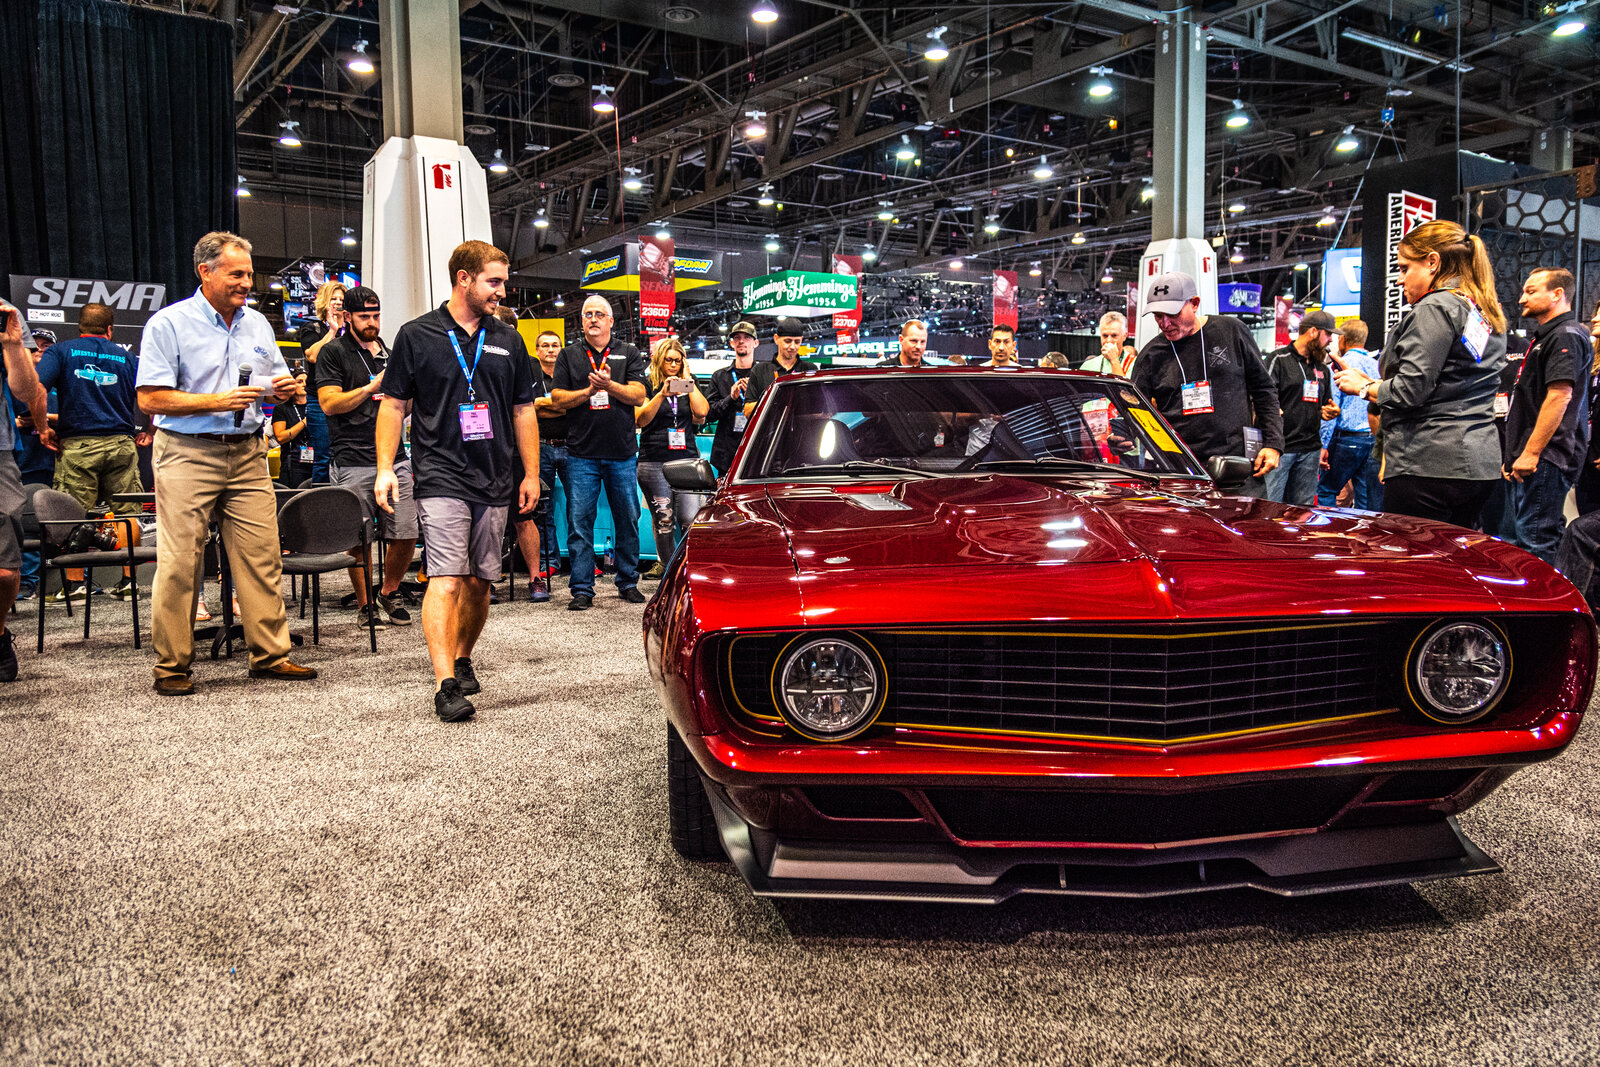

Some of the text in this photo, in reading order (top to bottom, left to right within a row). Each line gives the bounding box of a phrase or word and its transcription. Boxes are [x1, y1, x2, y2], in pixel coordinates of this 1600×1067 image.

[1389, 196, 1402, 274] AMERICAN
[27, 278, 166, 311] SEMA
[743, 280, 787, 309] Hemmings
[787, 275, 857, 302] Hemmings
[760, 299, 774, 308] 1954
[814, 297, 836, 306] 1954
[642, 307, 670, 317] 23600
[834, 318, 858, 328] 23700
[823, 340, 903, 355] CHEVROLET
